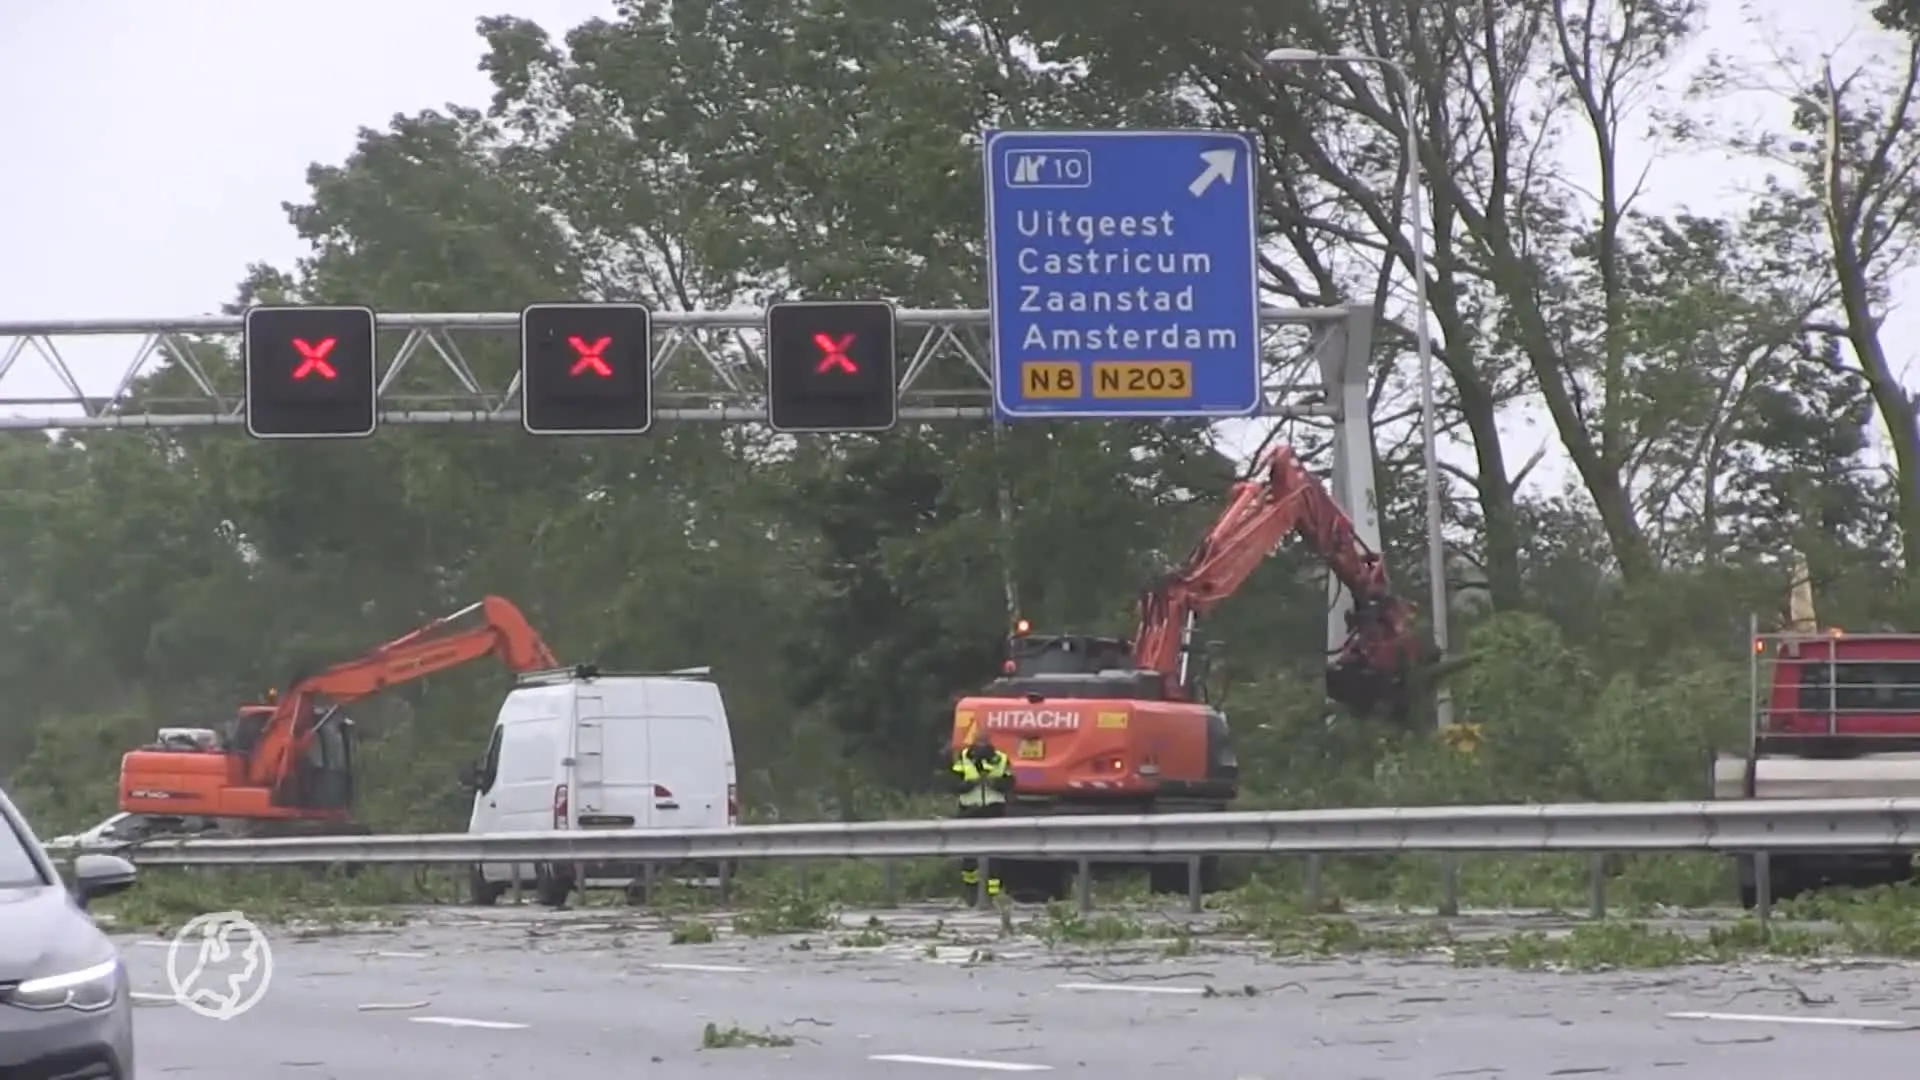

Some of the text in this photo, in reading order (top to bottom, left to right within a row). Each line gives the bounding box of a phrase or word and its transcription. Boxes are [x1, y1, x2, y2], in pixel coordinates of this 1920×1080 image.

[1053, 158, 1082, 179] 10
[1016, 210, 1175, 245] Uitgeest
[1017, 248, 1211, 274] Castricum
[1019, 285, 1194, 312] Zaanstad
[1022, 323, 1236, 350] Amsterdam
[986, 710, 1080, 729] HITACHI
